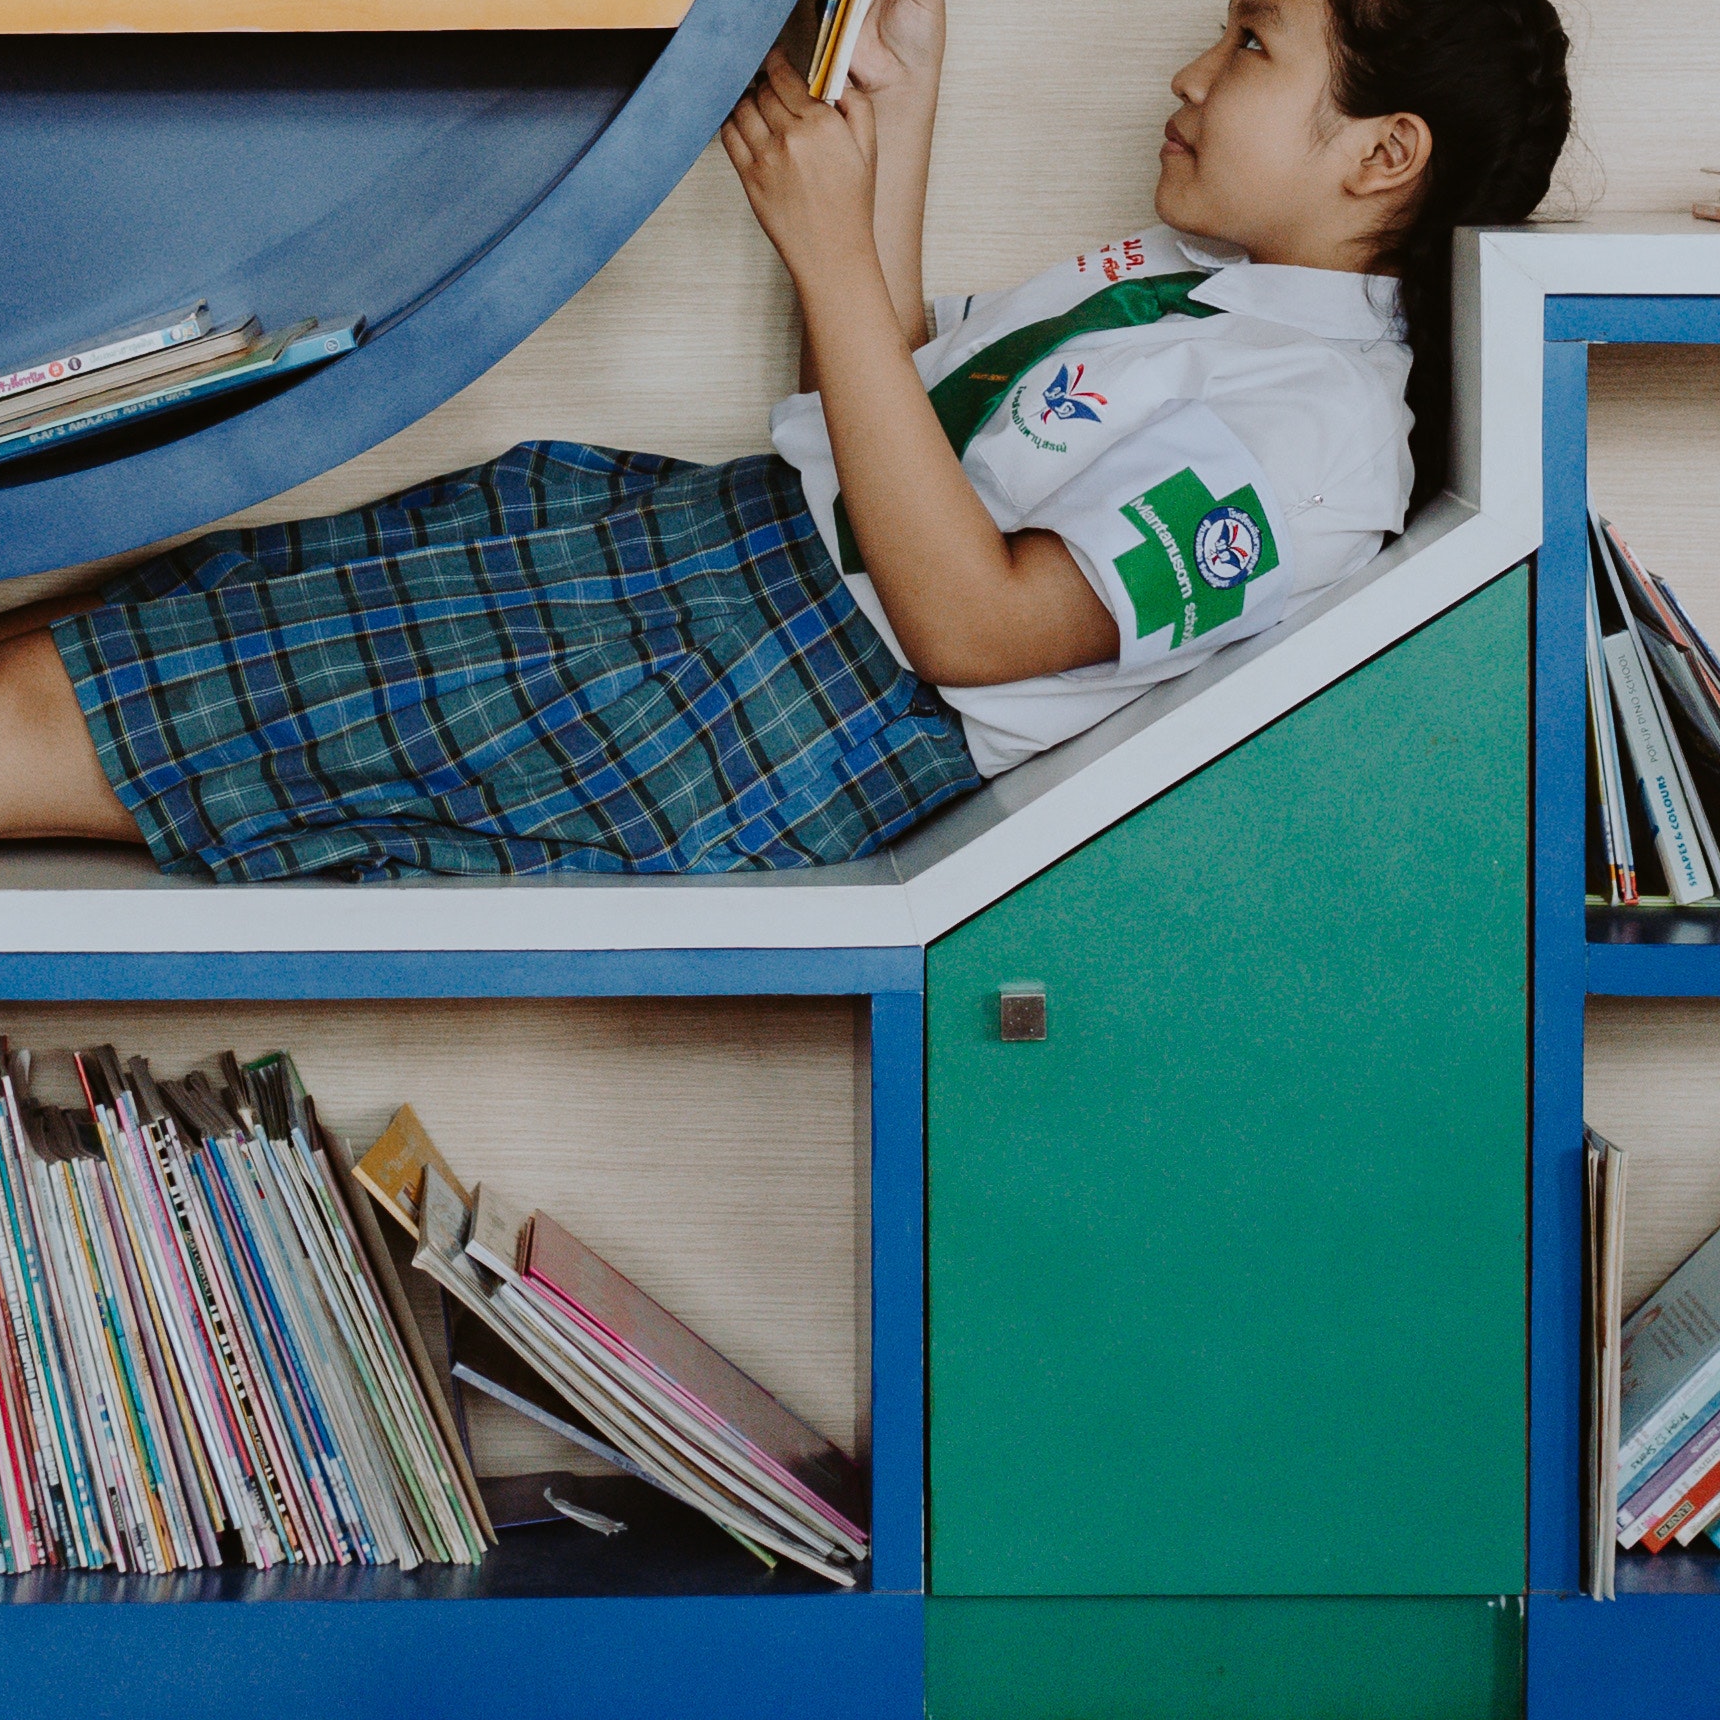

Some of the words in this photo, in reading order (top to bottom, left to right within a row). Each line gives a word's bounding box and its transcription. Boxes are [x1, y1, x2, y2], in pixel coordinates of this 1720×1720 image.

[1616, 652, 1638, 695] SCHOOL
[1629, 695, 1647, 726] DINO
[1639, 726, 1659, 763] POP-UP
[1654, 774, 1680, 831] COLOURS
[1671, 830, 1683, 840] &
[1675, 841, 1698, 887] SHAPES
